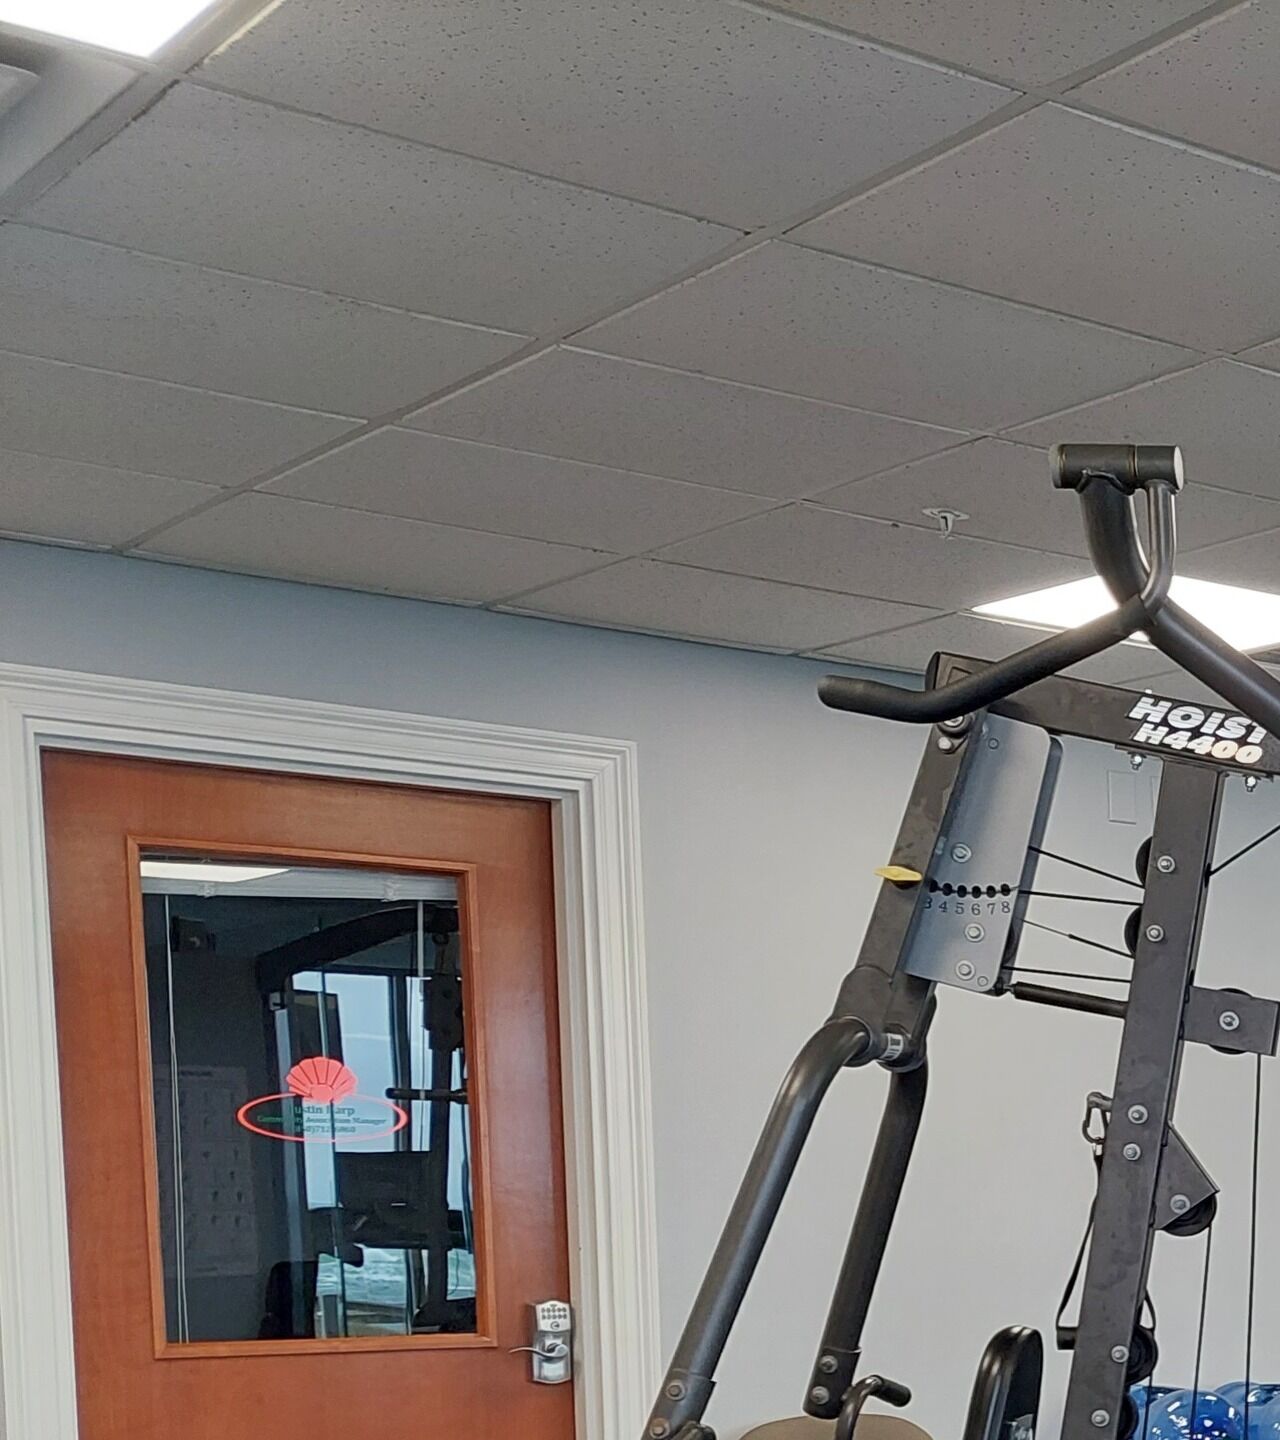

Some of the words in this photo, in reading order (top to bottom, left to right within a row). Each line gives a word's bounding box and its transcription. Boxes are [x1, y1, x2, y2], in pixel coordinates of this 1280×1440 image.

[1128, 696, 1267, 744] HOIST
[1133, 723, 1263, 764] H4400
[939, 901, 948, 912] 4
[955, 903, 964, 914] 5
[971, 903, 981, 915] 6
[987, 903, 996, 915] 7
[1001, 901, 1011, 913] 8
